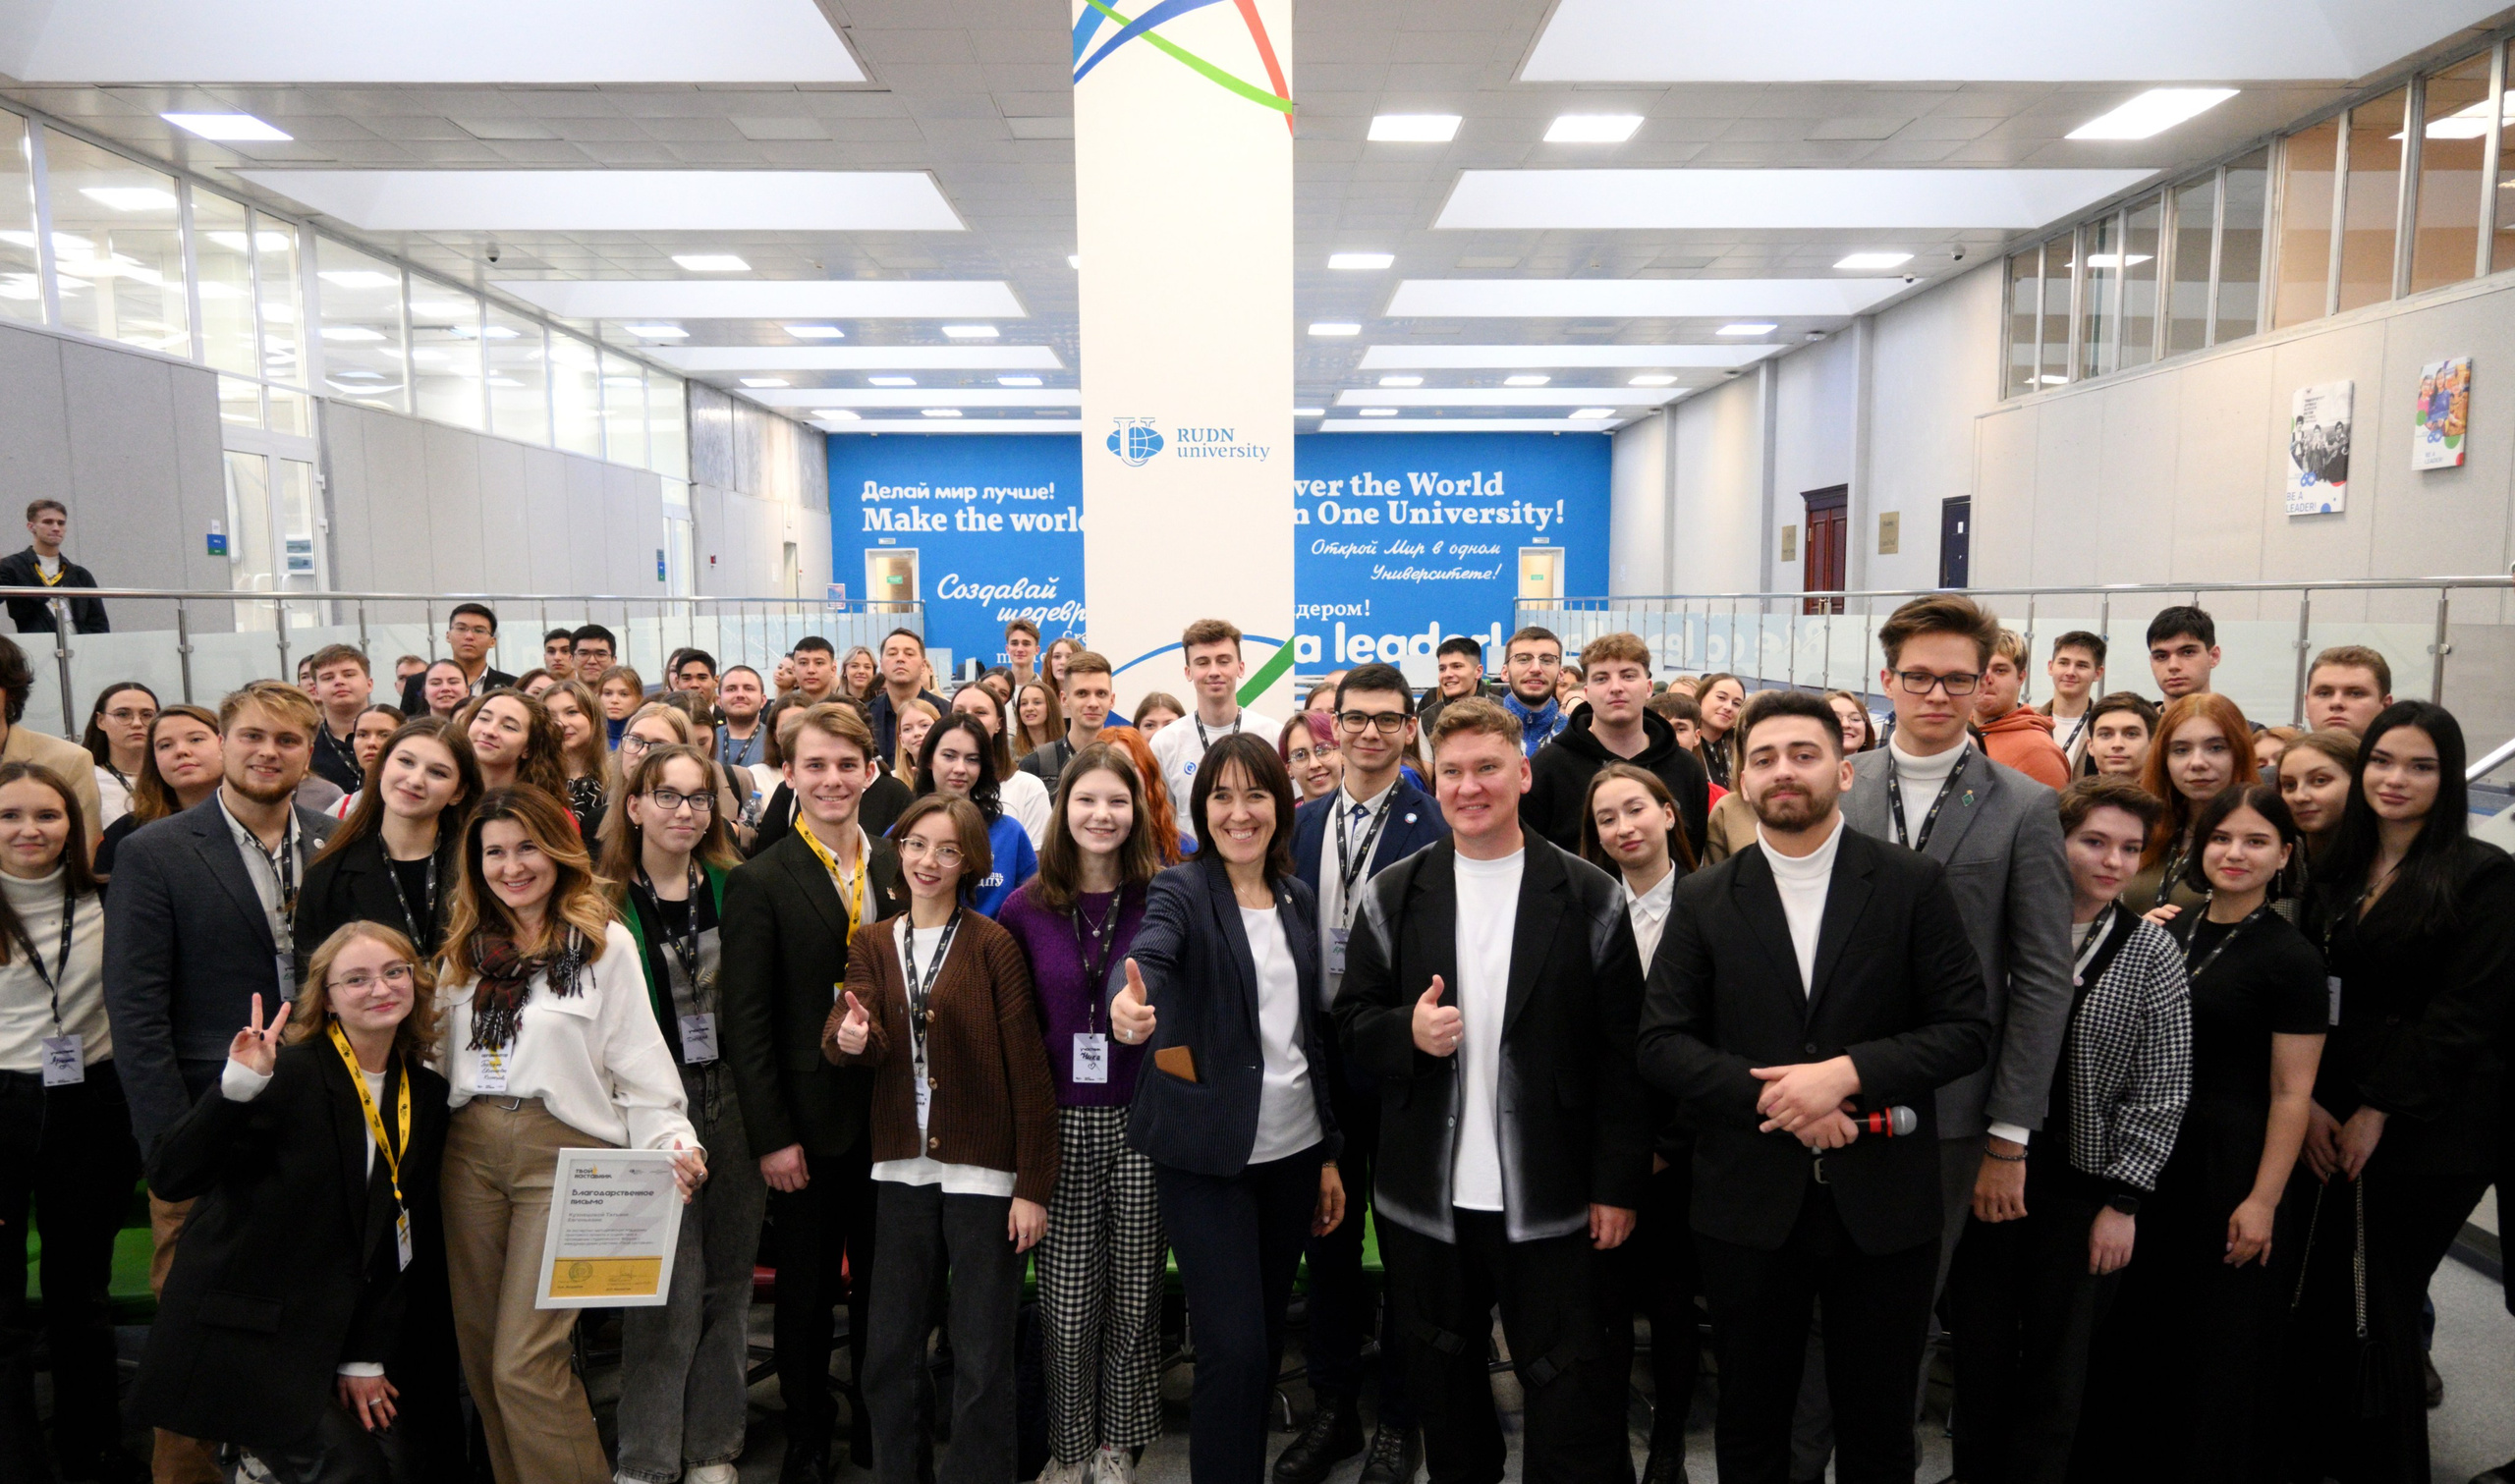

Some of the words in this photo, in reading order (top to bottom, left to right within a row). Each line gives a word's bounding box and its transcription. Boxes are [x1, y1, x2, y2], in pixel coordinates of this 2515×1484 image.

[1177, 428, 1235, 442] RUDN
[1177, 443, 1270, 462] university
[862, 480, 930, 502] Делай
[935, 486, 978, 504] мир
[981, 481, 1055, 505] лучше!
[1349, 471, 1401, 497] the
[1407, 470, 1504, 496] World
[2286, 503, 2317, 513] LEADER!
[2287, 492, 2296, 501] BE
[862, 506, 948, 532] Make
[954, 506, 1003, 532] the
[1317, 500, 1379, 524] One
[1386, 499, 1564, 532] University!
[1311, 539, 1378, 559] Открой
[1383, 539, 1425, 559] Мир
[1432, 540, 1444, 554] в
[1449, 543, 1501, 560] одном
[1370, 564, 1503, 584] Университете!
[937, 573, 1060, 607] Создавай
[1294, 634, 1321, 664] a
